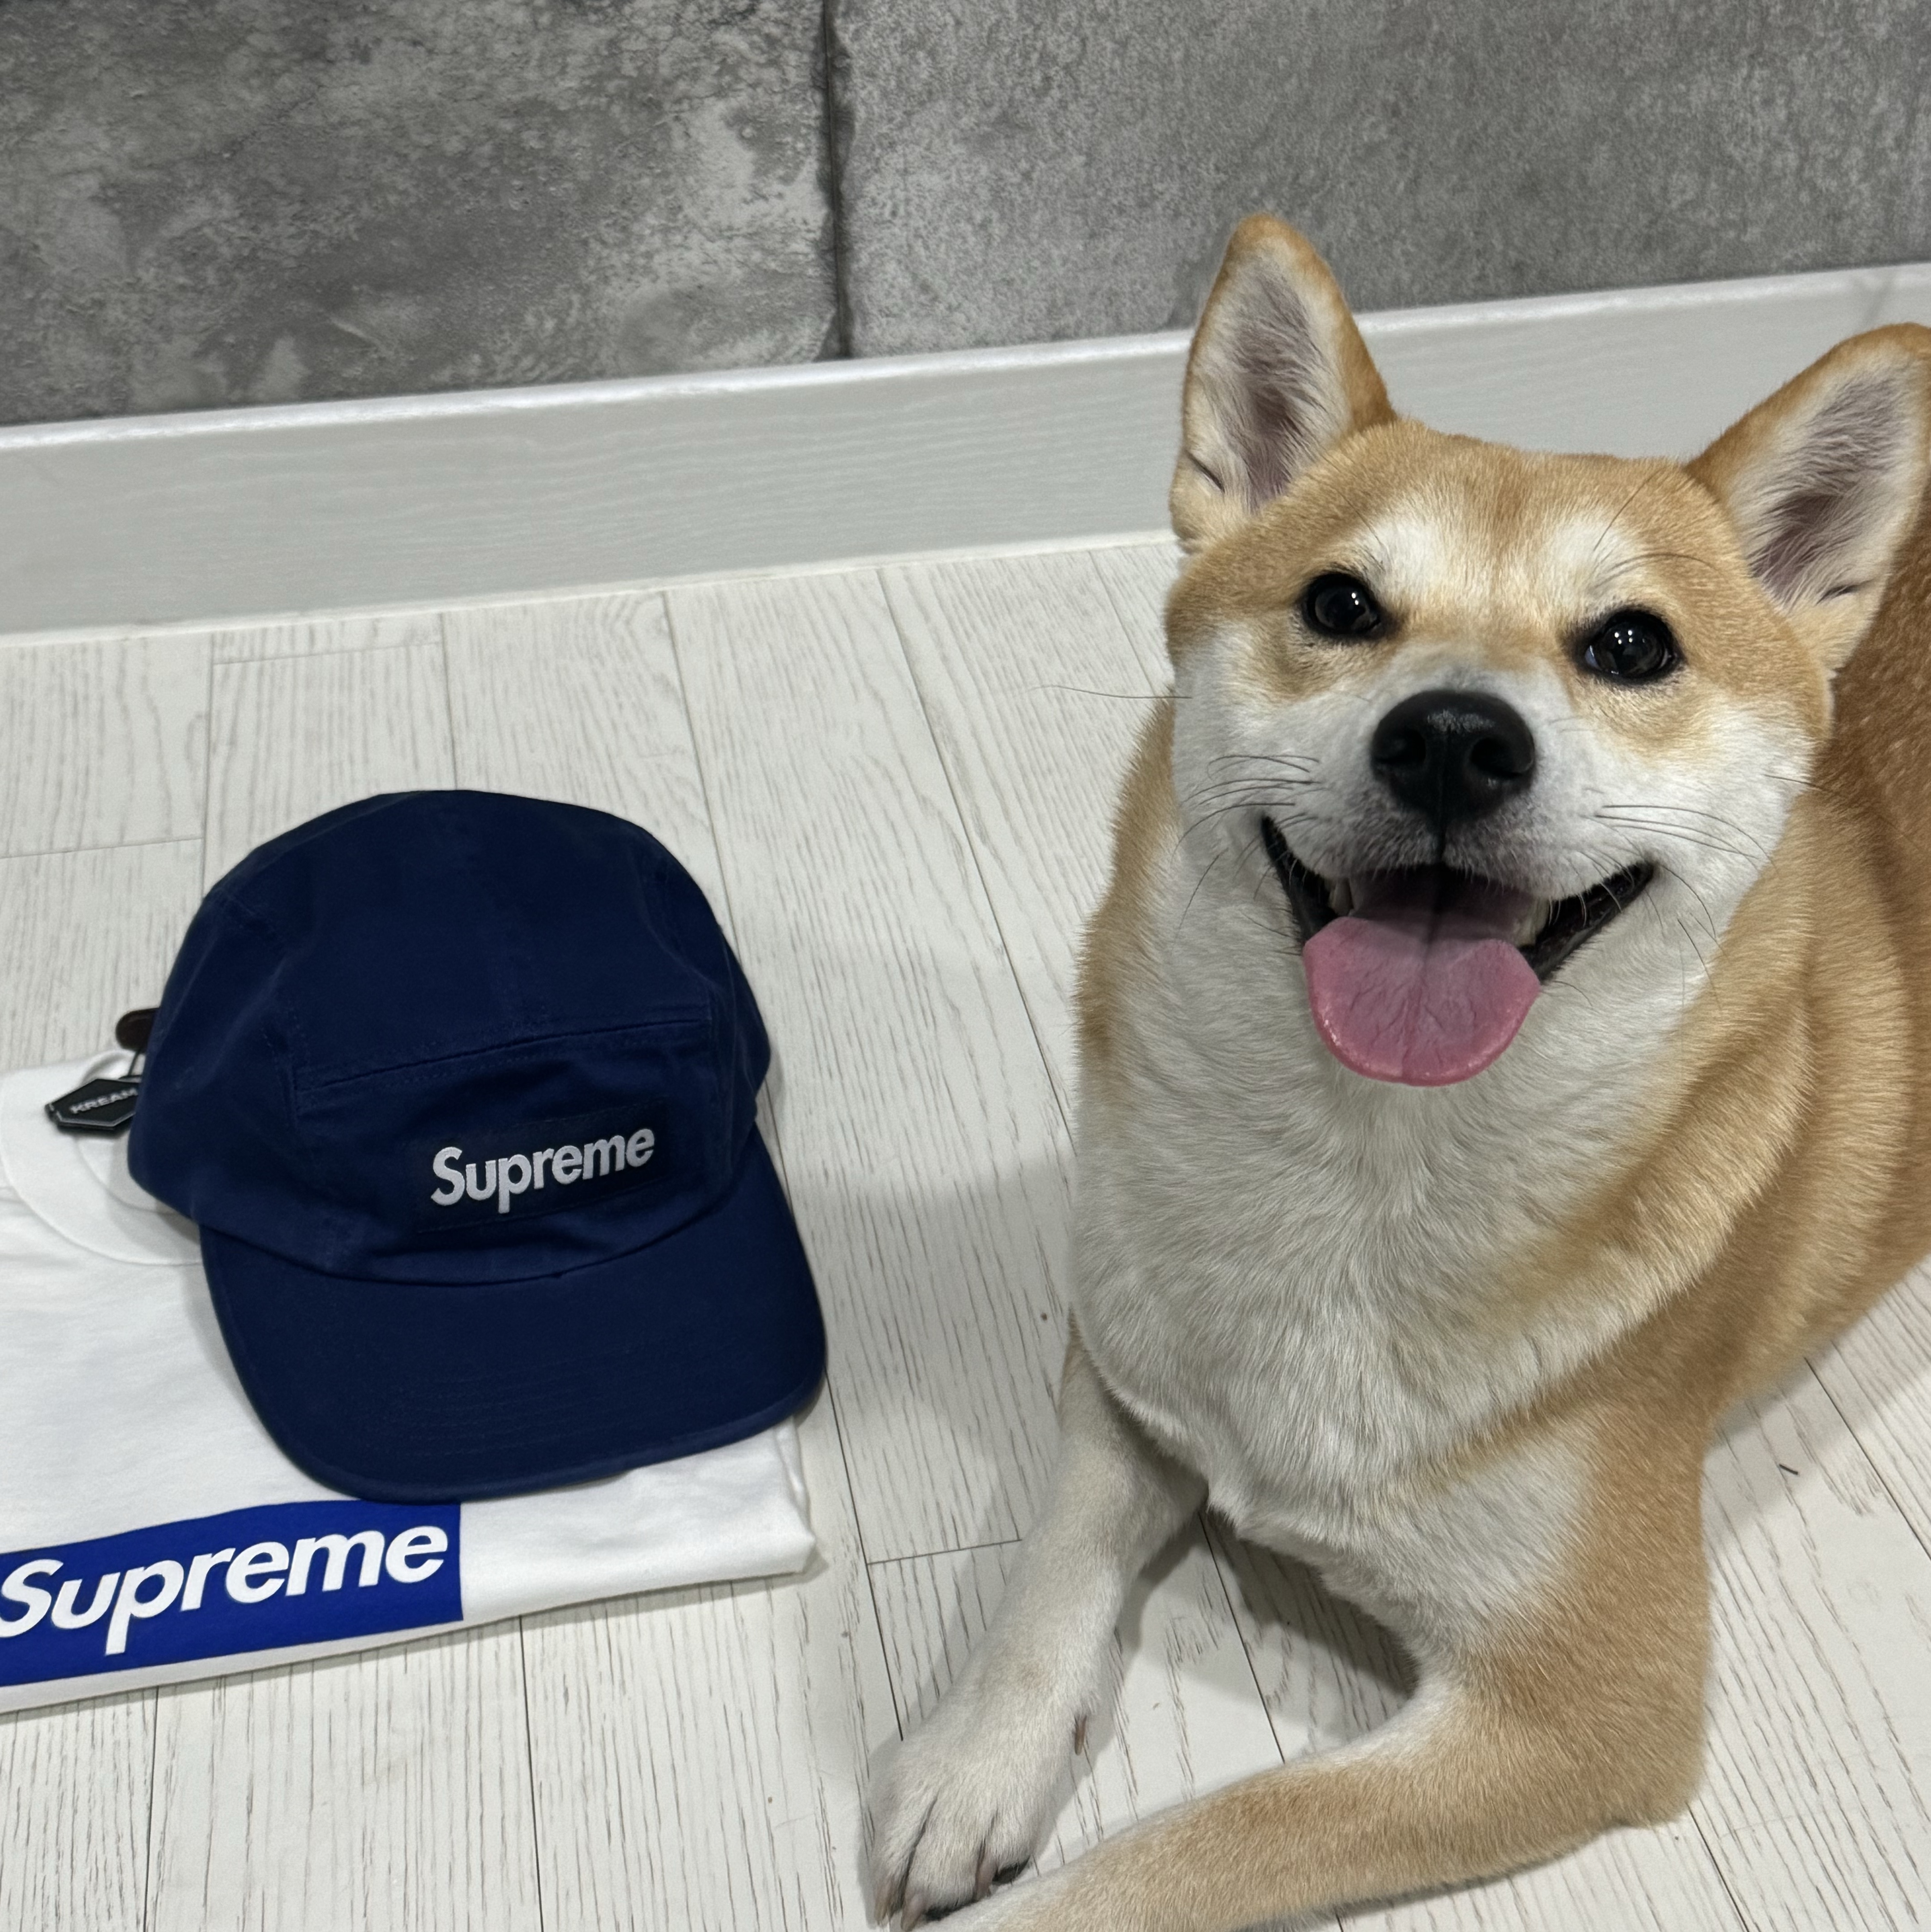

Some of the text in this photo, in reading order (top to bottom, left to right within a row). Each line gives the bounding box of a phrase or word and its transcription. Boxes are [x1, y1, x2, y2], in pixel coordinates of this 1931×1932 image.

[69, 1087, 138, 1114] KREAM
[431, 1128, 655, 1214] Supreme
[0, 1525, 448, 1656] Supreme
